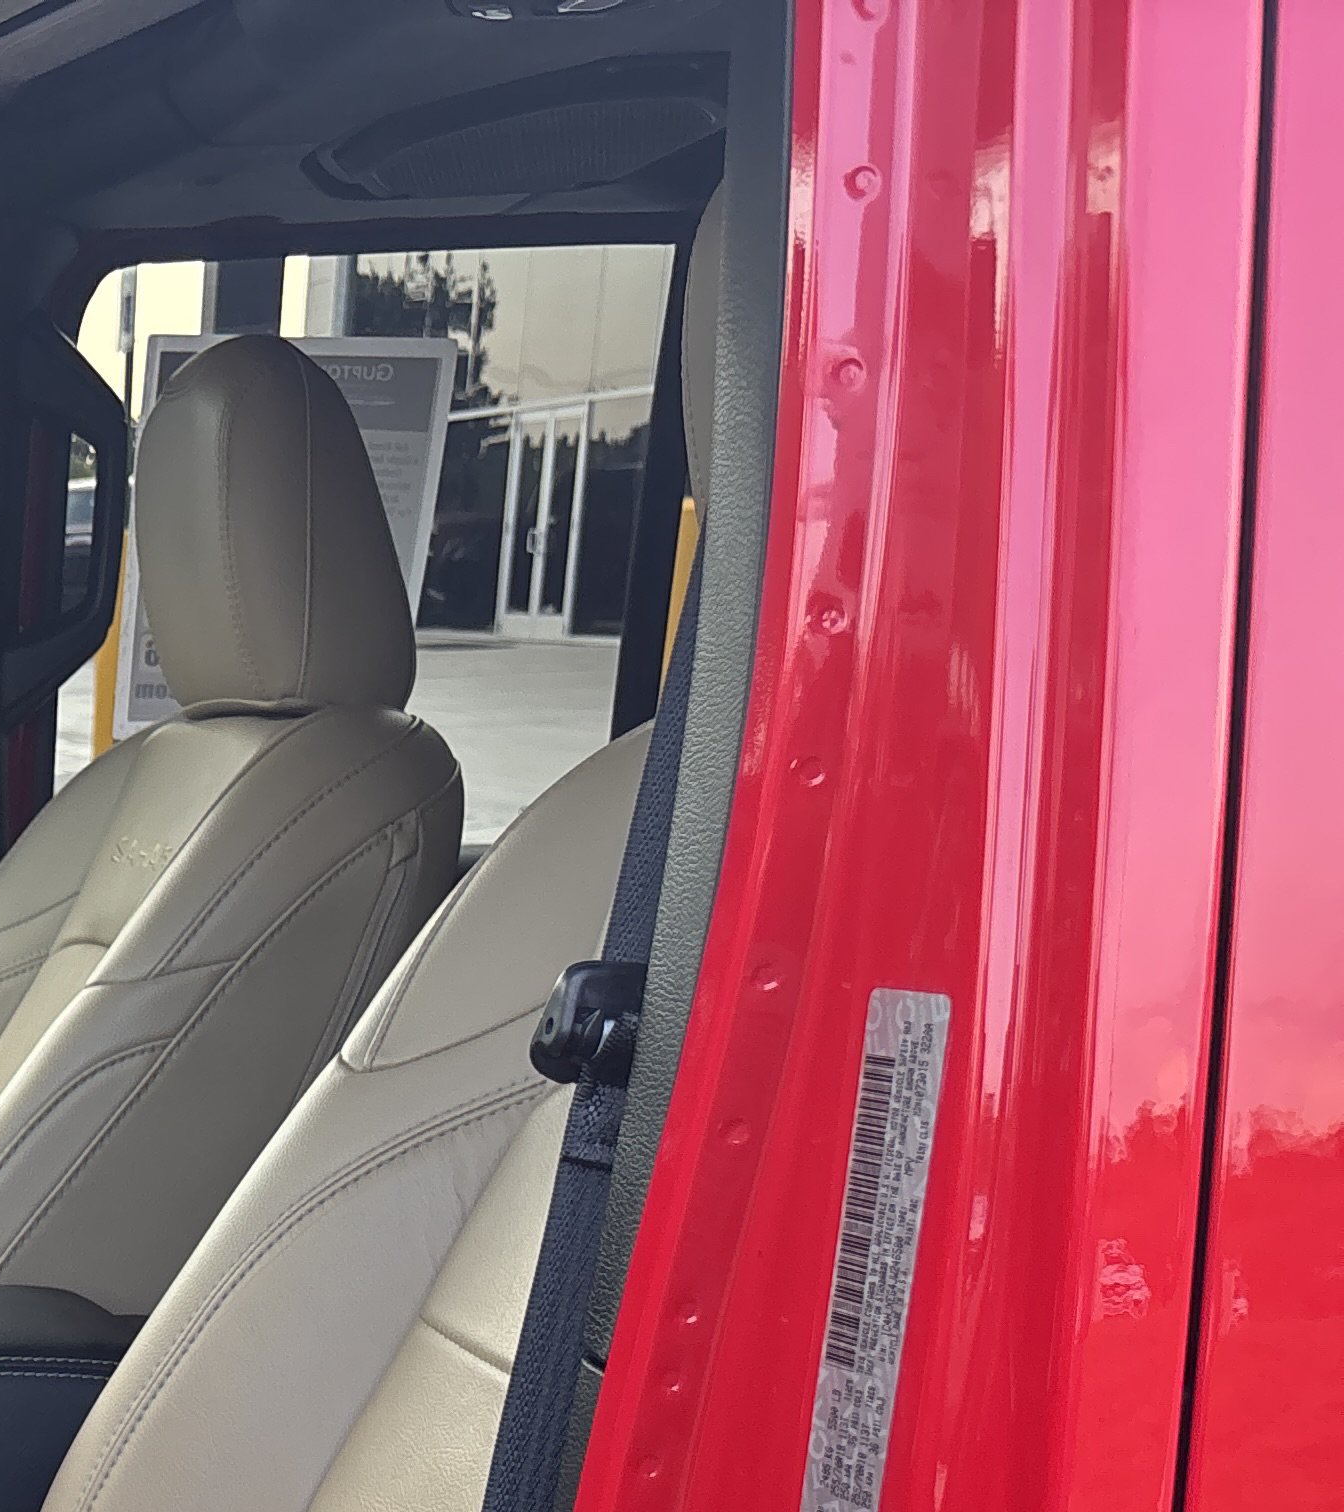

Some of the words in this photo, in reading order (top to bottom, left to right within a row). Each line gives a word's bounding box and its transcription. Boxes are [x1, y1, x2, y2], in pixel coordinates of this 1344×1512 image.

[903, 1156, 915, 1176] MPV
[823, 1445, 833, 1459] KG
[830, 1388, 841, 1402] LB
